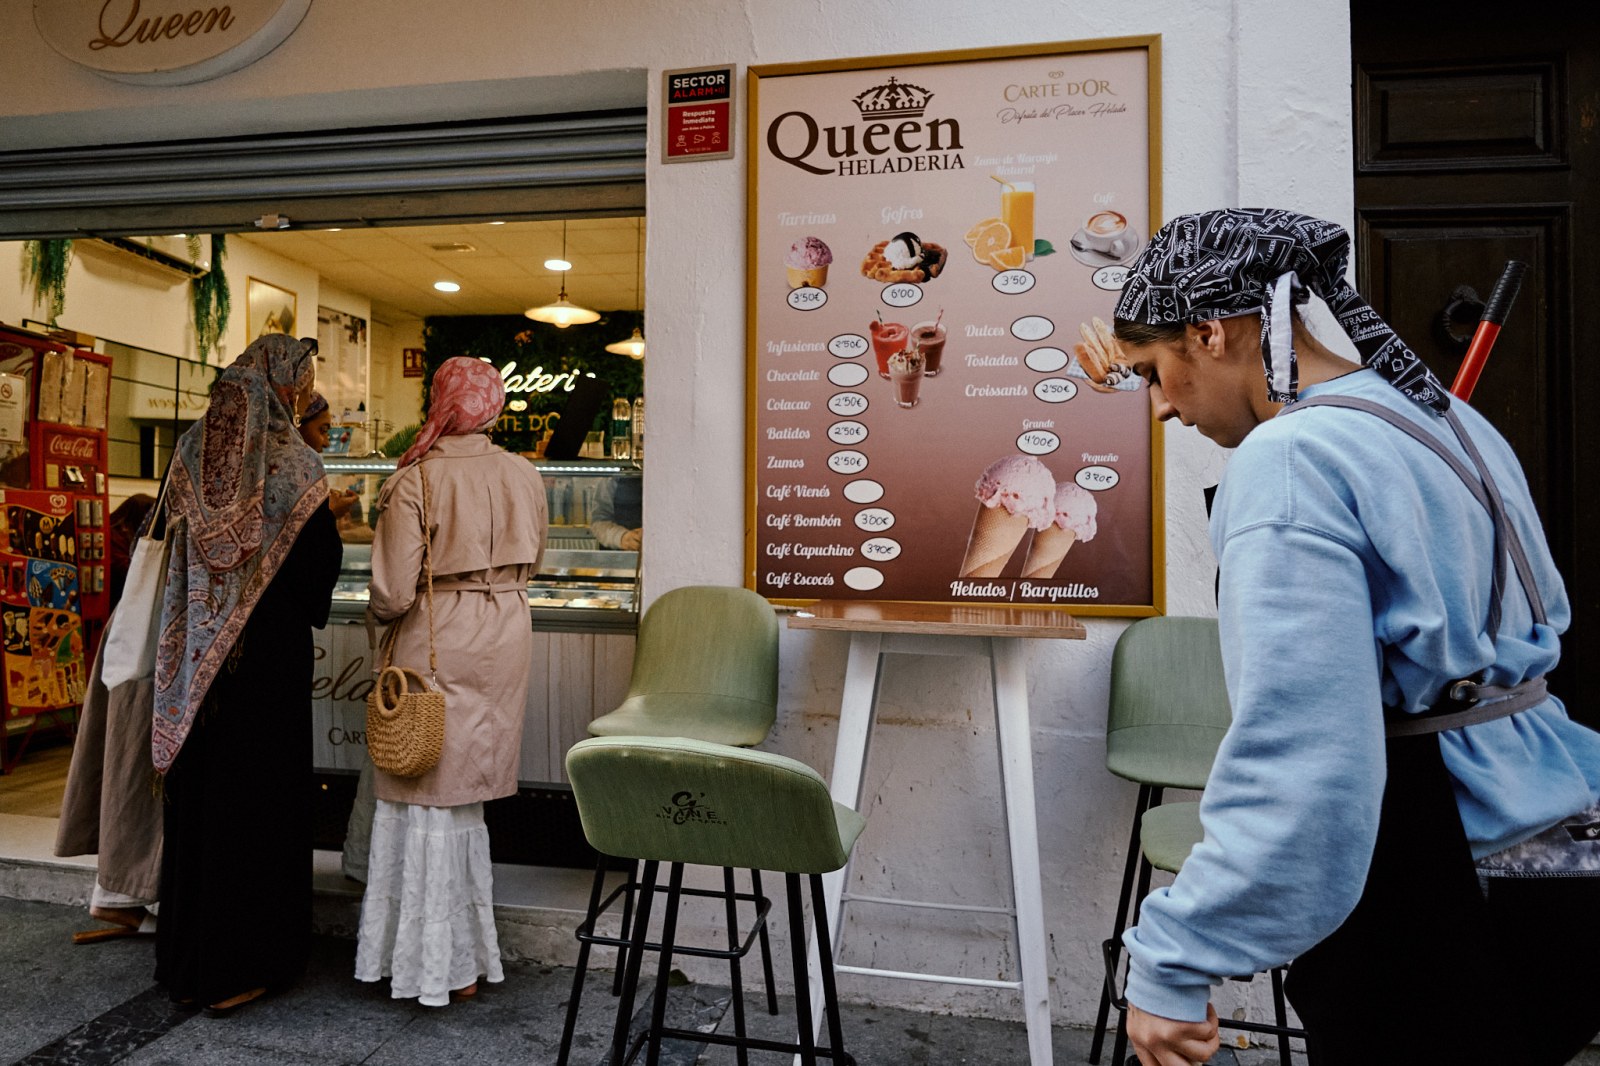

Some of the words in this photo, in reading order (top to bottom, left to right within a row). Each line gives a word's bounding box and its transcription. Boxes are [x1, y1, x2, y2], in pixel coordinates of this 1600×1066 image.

[88, 0, 236, 51] Queen
[674, 74, 725, 88] SECTOR
[673, 87, 714, 98] ALARM
[1003, 83, 1060, 103] CARTE
[1067, 79, 1118, 97] D'OR
[767, 111, 964, 176] Queen
[838, 153, 965, 176] HELADERIA
[777, 211, 837, 226] Tarrinas
[881, 206, 924, 225] Gofres
[1343, 310, 1381, 328] FRASC
[964, 324, 1005, 337] Dulces
[766, 340, 826, 356] Infusiones
[964, 354, 1019, 367] Tostadas
[499, 360, 597, 393] lateri
[766, 369, 820, 382] Chocolate
[965, 384, 1029, 397] Croissants
[766, 398, 811, 411] Colacao
[1022, 418, 1055, 430] Grande
[766, 426, 811, 440] Batidos
[766, 456, 805, 469] Zumos
[1081, 452, 1119, 465] Pequeño
[766, 484, 792, 501] Café
[793, 484, 831, 498] Vienés
[766, 513, 792, 531] Café
[793, 513, 841, 527] Bombón
[766, 543, 792, 560] Café
[793, 542, 855, 560] Capuchino
[766, 572, 792, 589] Café
[793, 572, 835, 586] Escocés
[949, 581, 1007, 597] Helados
[1019, 582, 1099, 602] Barquillos
[328, 727, 368, 746] CART
